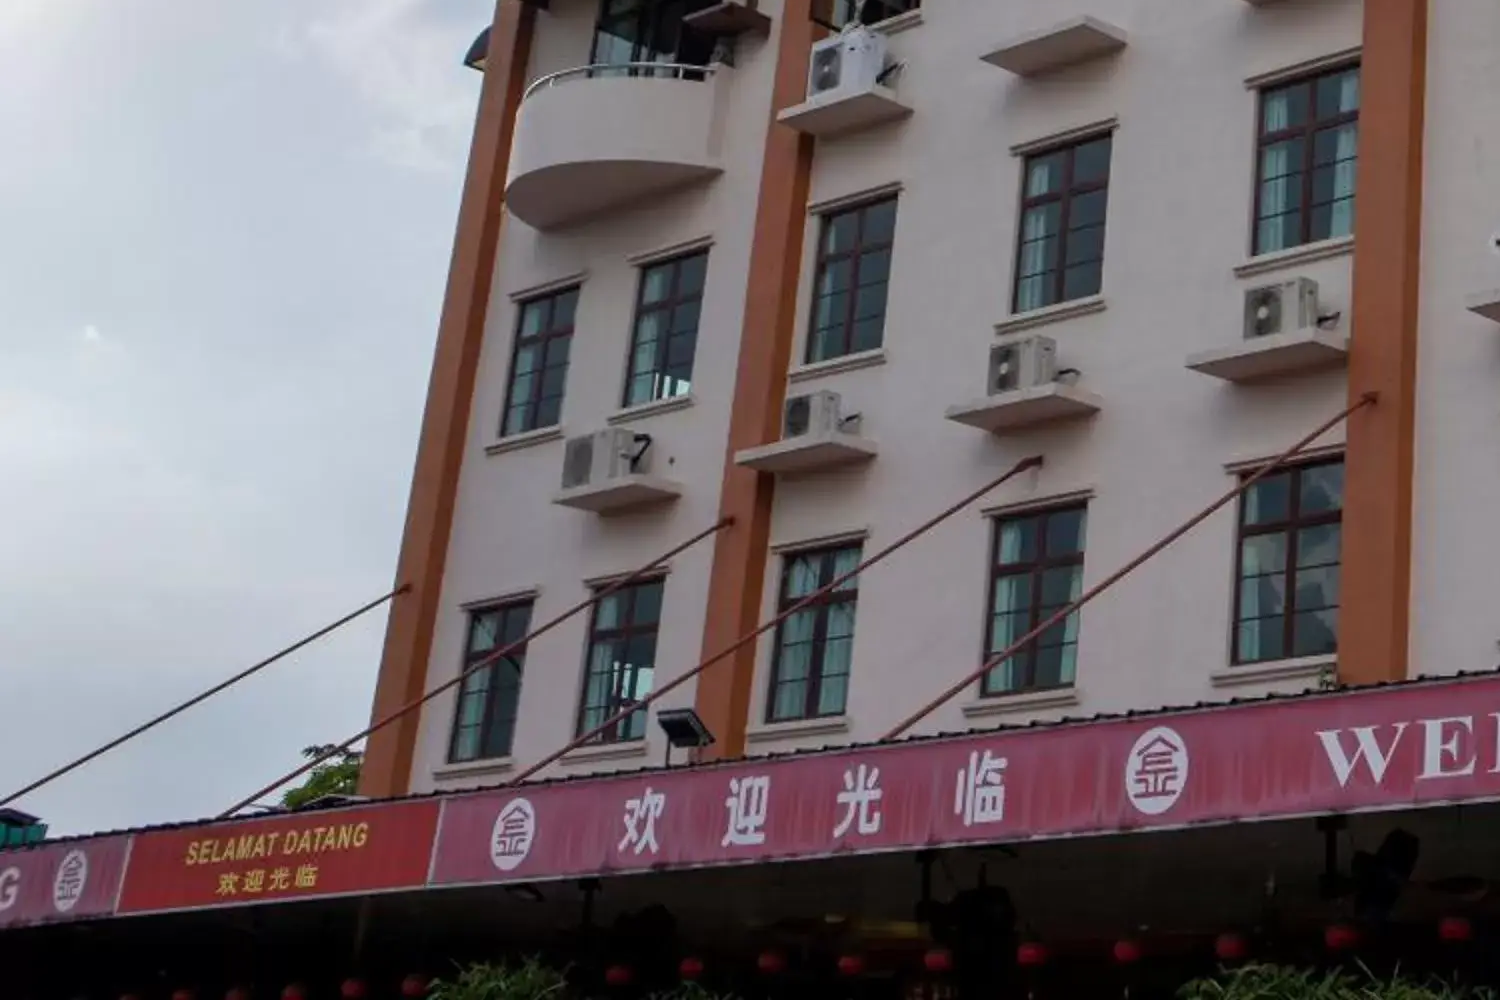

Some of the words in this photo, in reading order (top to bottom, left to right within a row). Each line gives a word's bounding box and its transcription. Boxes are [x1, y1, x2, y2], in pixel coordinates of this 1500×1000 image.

[618, 750, 1008, 855] 欢迎光临
[185, 832, 279, 866] SELAMAT
[283, 822, 369, 856] DATANG
[215, 864, 319, 896] 欢迎光临
